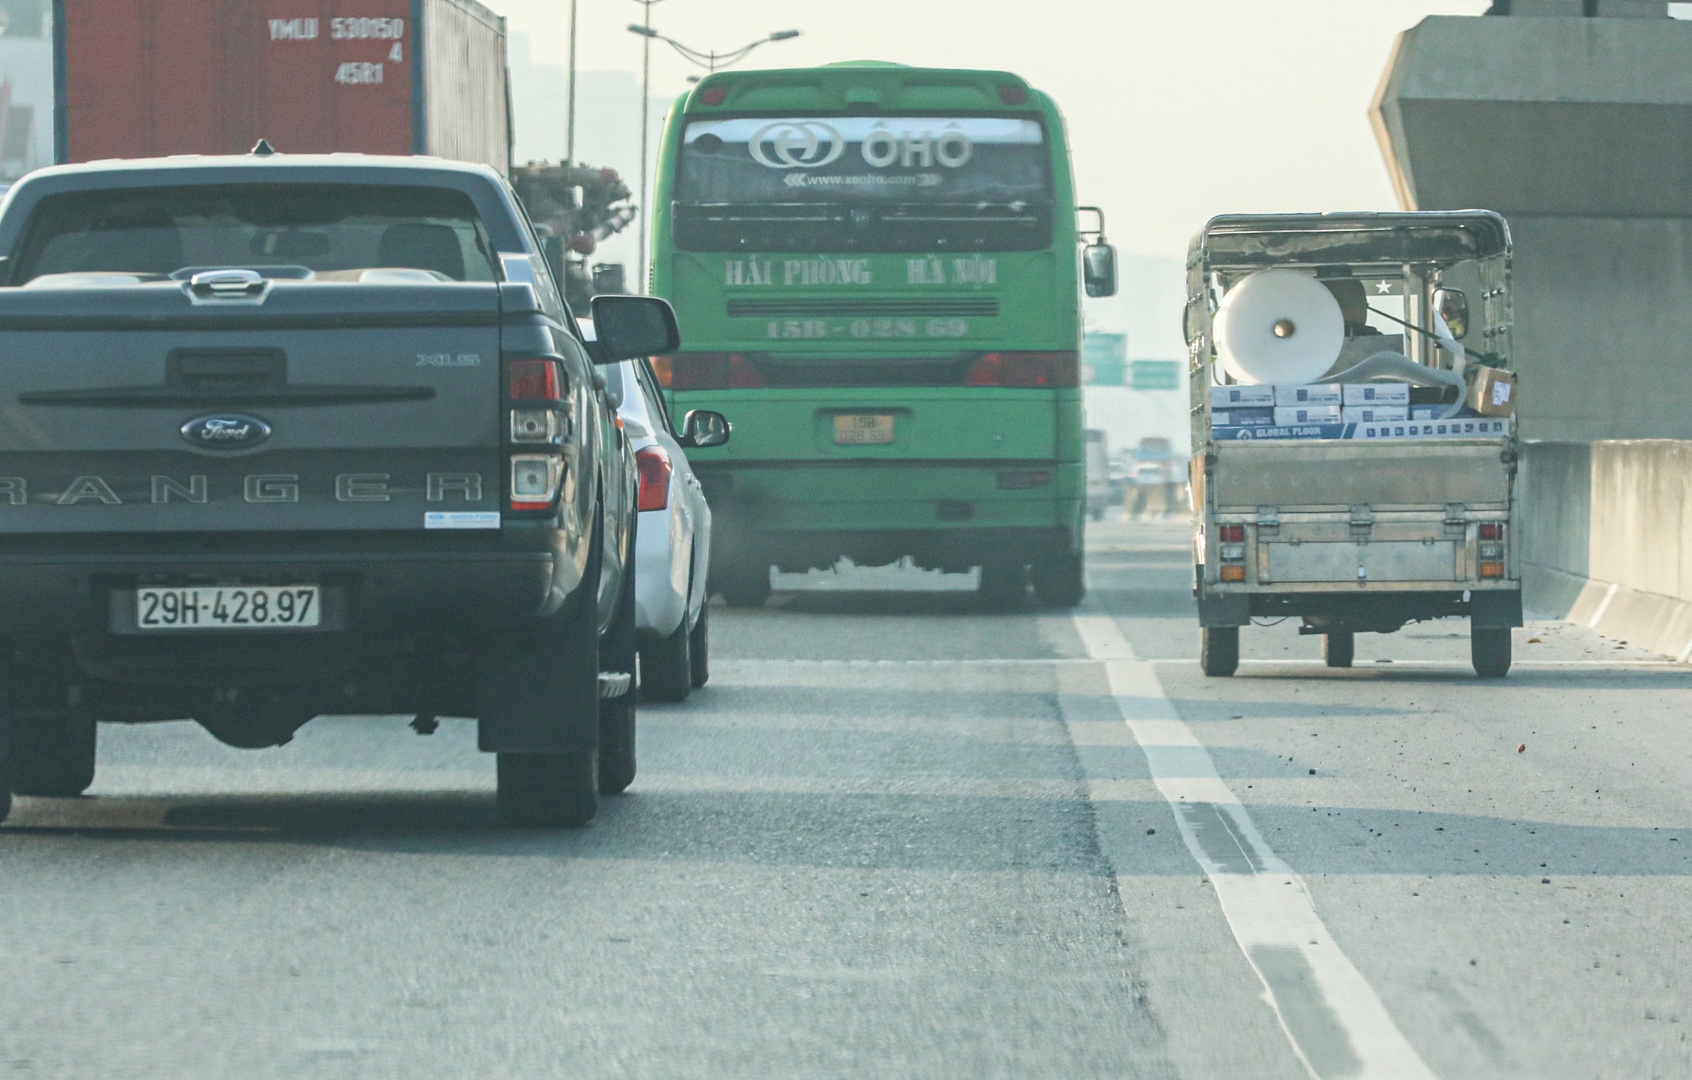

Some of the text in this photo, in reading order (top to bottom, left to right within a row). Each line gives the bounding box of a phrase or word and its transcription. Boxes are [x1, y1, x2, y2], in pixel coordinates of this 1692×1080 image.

[267, 17, 404, 40] YMLU 530150
[388, 41, 403, 62] 4
[334, 62, 384, 84] 45R1
[201, 419, 250, 439] Ford
[1256, 427, 1321, 437] GLOBAL FLOOR
[0, 473, 483, 505] RANGER
[142, 590, 315, 625] 29H-428.97
